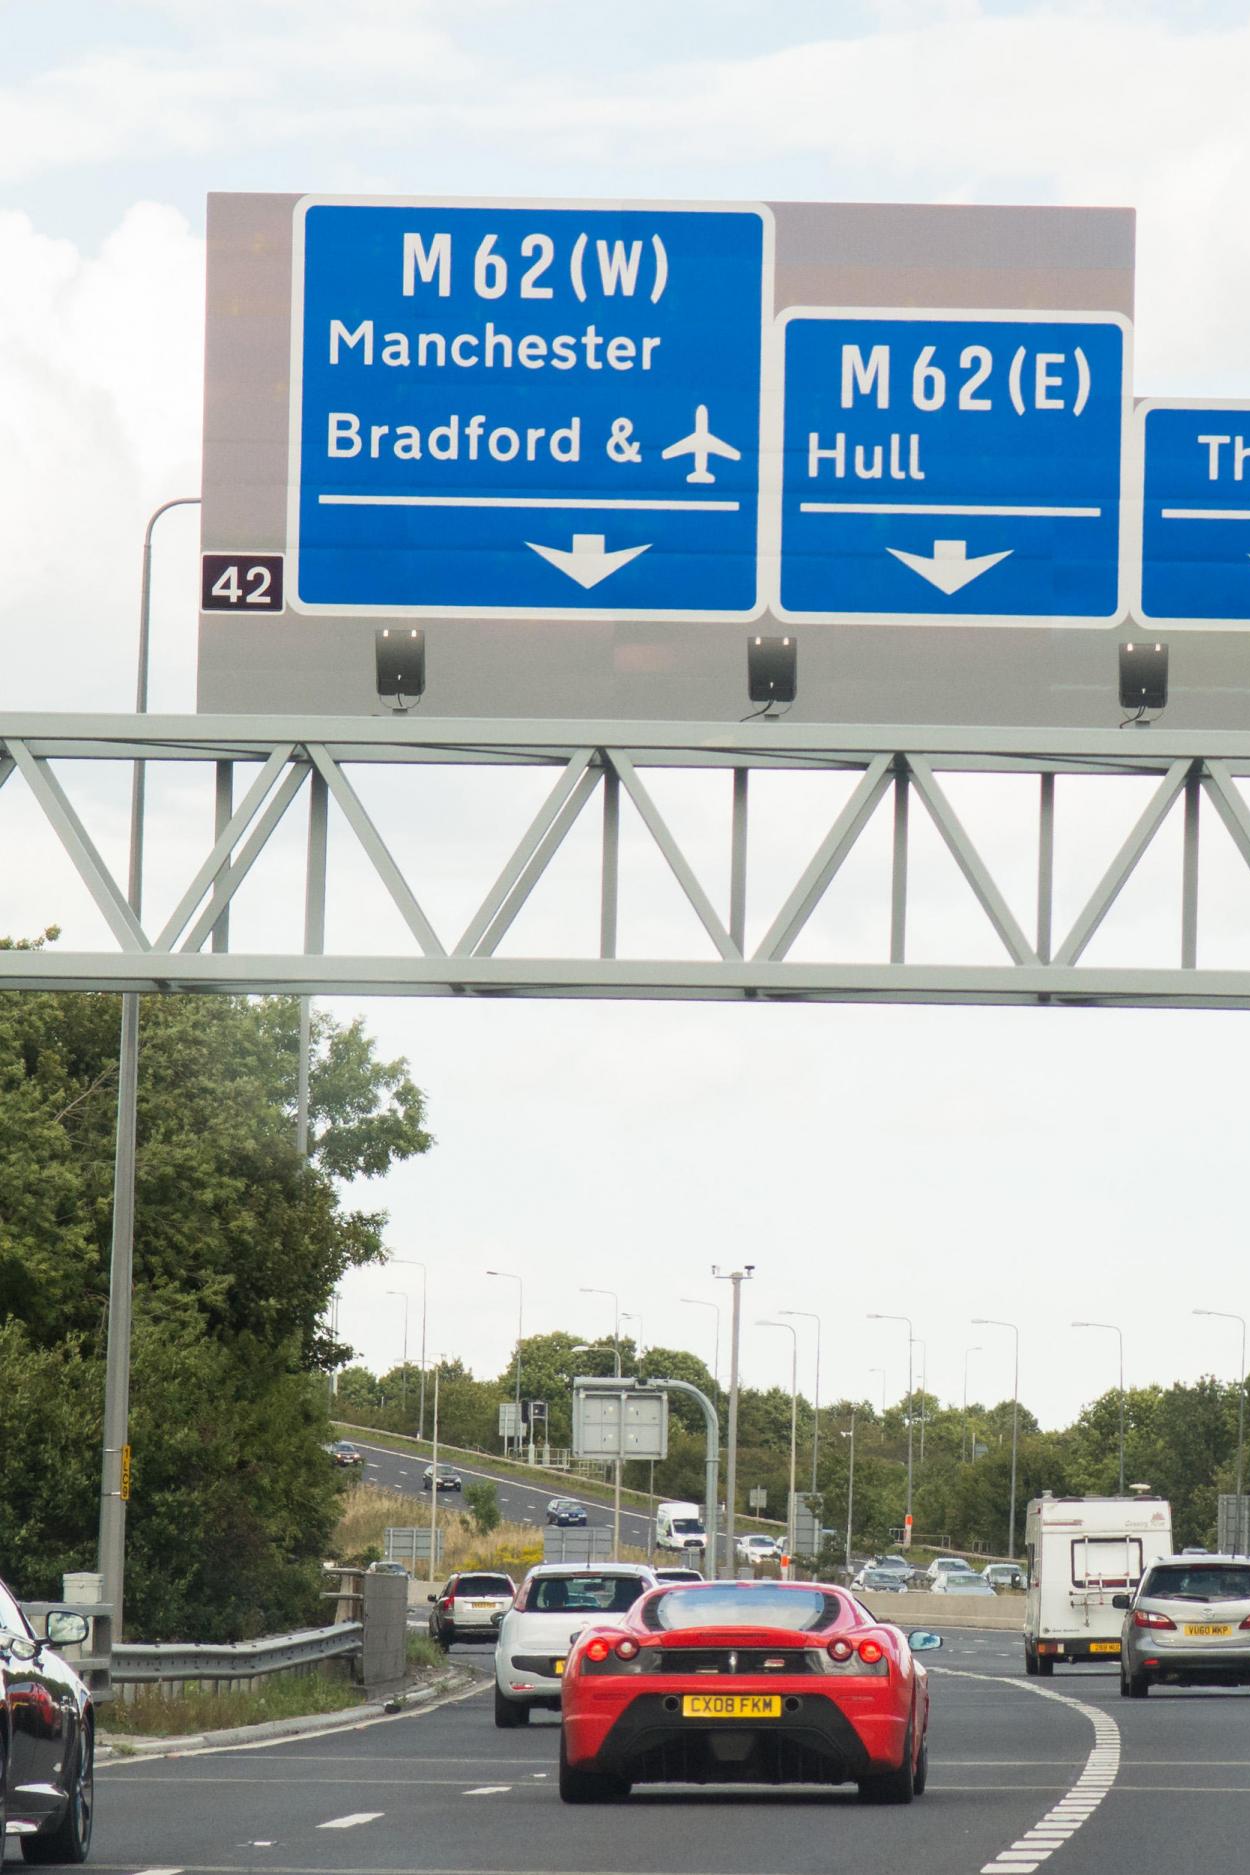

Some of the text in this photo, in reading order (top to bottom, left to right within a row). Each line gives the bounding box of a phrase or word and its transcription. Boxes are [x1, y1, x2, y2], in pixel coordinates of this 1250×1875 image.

[329, 319, 661, 371] Manchester
[327, 412, 642, 463] Bradford &
[808, 432, 925, 480] Hull
[211, 565, 272, 604] 42
[690, 1697, 773, 1713] CX08 FKM
